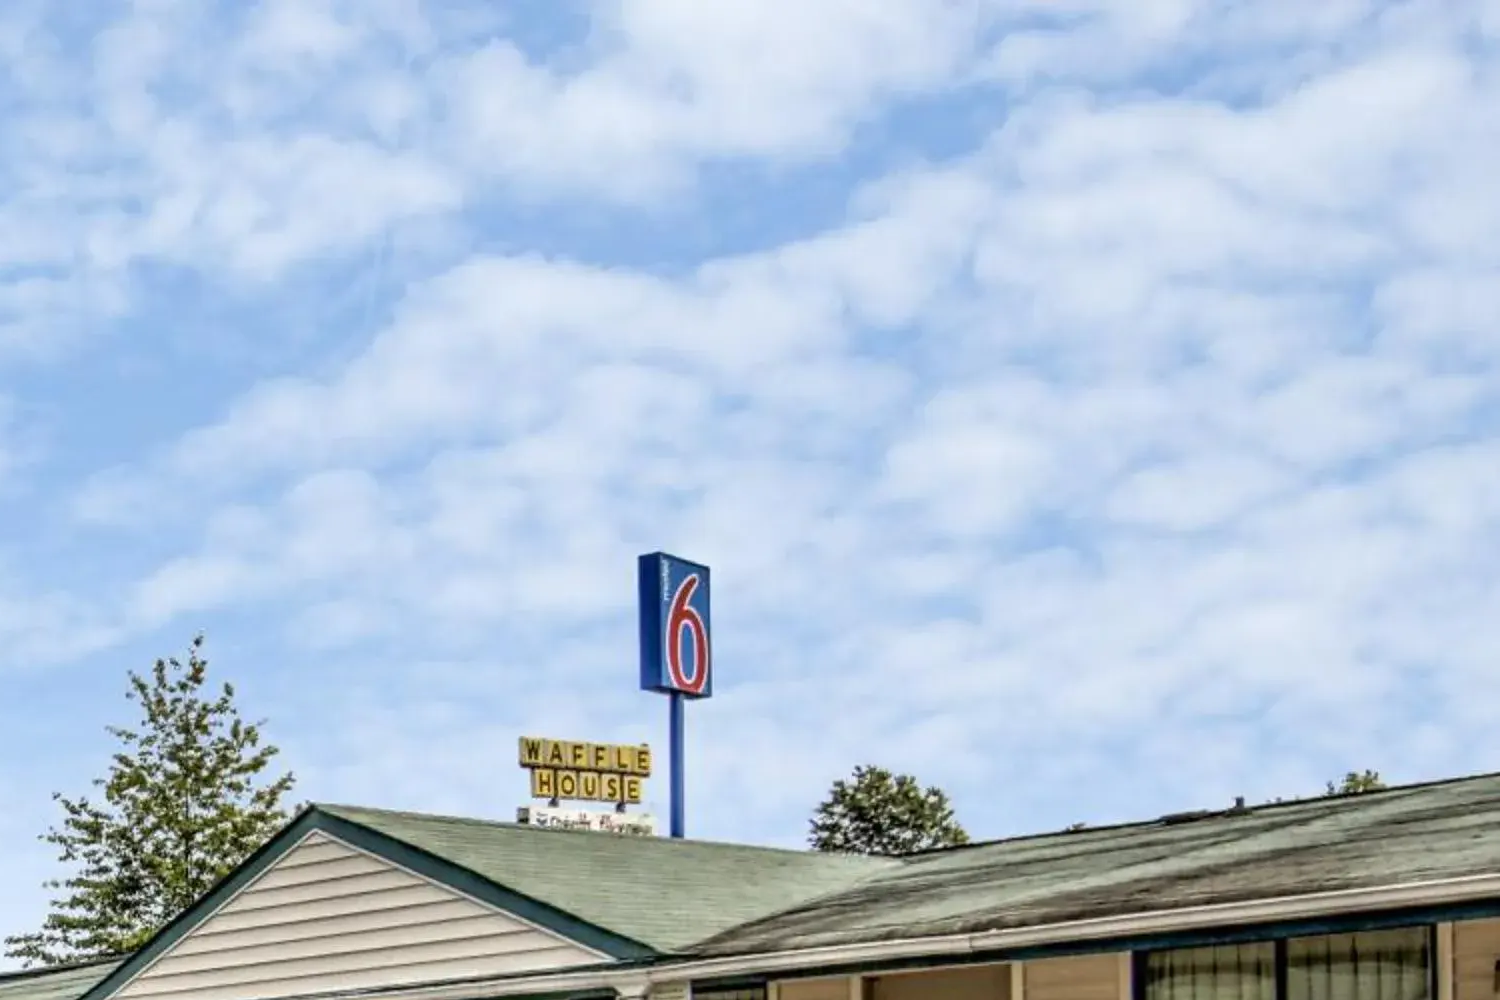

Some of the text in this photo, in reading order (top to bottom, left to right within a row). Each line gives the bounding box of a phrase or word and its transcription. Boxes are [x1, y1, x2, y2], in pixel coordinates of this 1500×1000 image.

[666, 573, 708, 694] 6
[525, 740, 649, 770] WAFFLE
[539, 773, 639, 799] HOUSE
